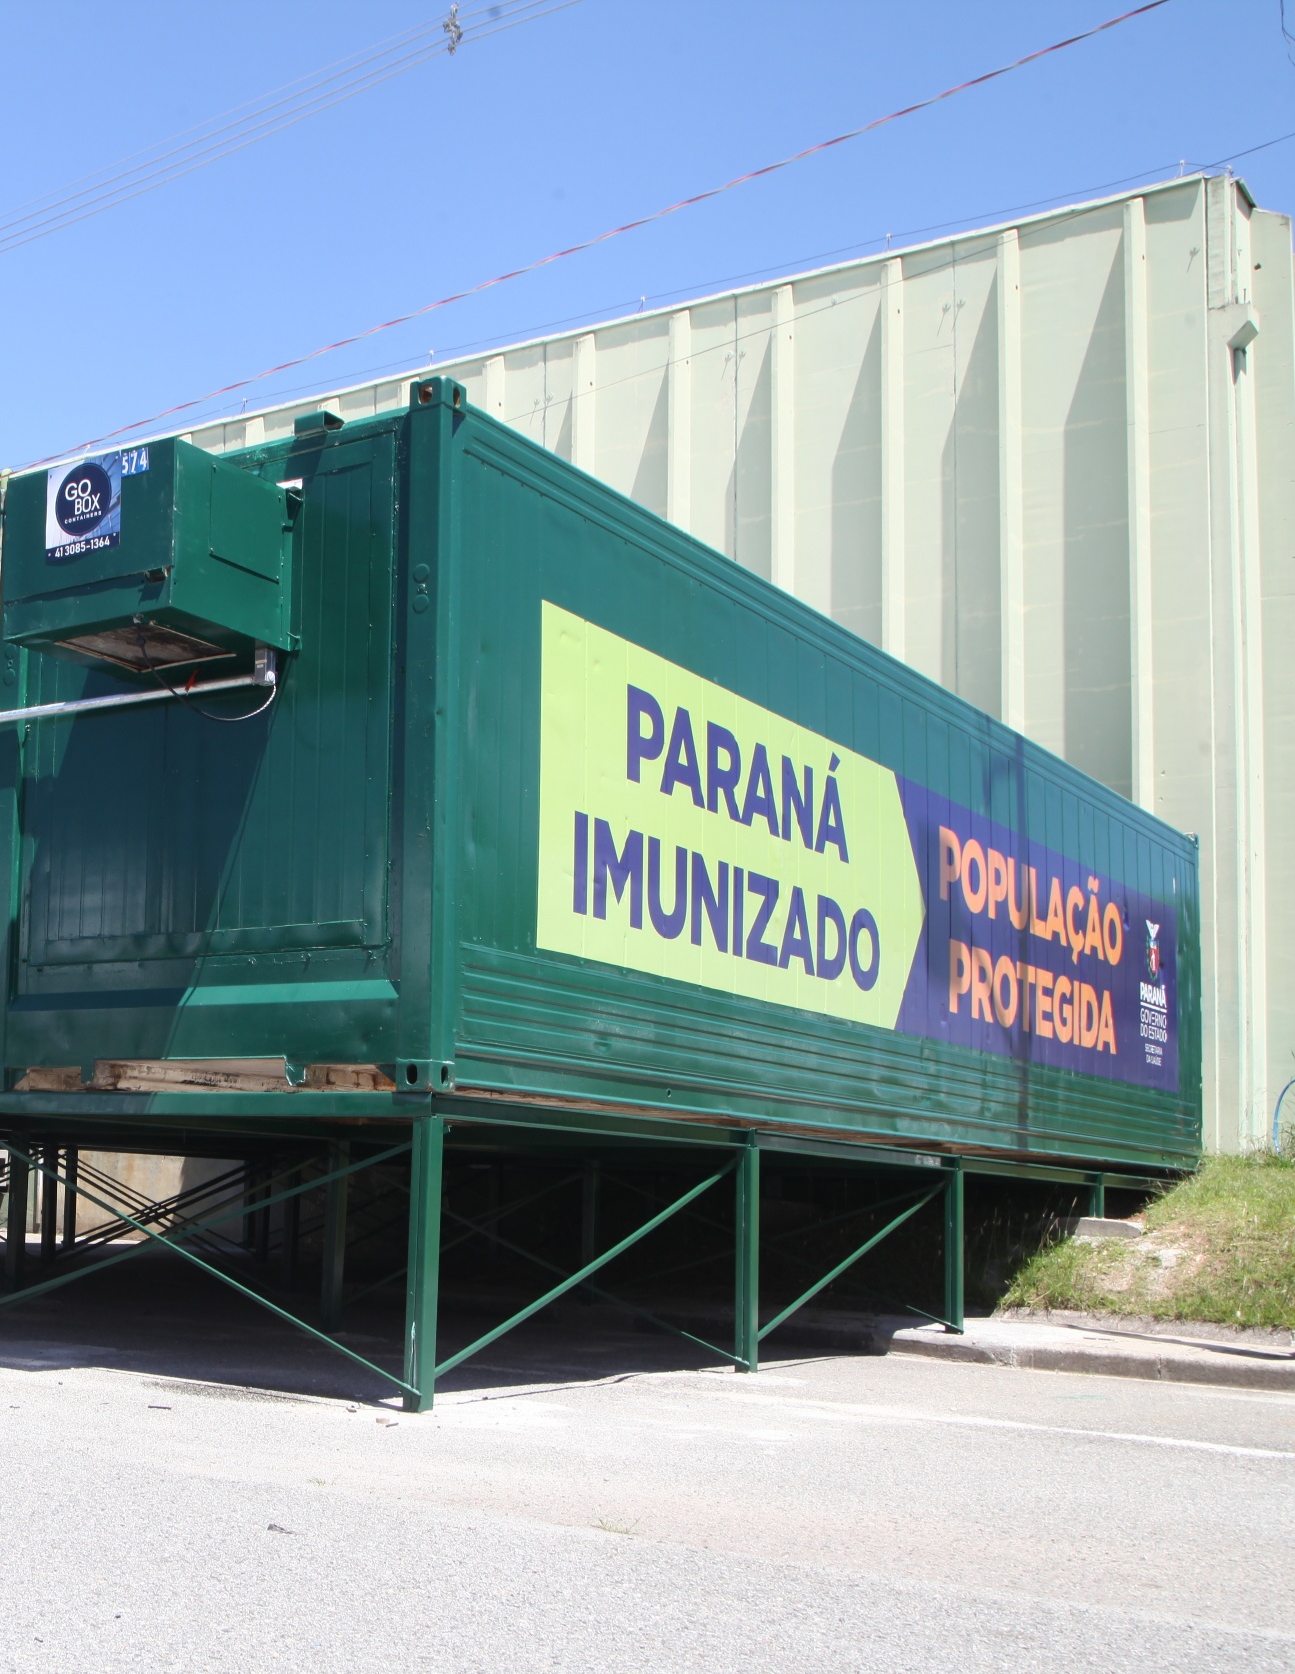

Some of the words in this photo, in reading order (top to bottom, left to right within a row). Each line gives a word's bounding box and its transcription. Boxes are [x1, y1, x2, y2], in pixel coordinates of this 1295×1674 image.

[121, 447, 148, 474] 574
[65, 479, 91, 501] GO
[74, 493, 100, 515] BOX
[64, 511, 102, 524] CONTAINERS
[626, 683, 849, 864] PARANÁ
[572, 810, 881, 992] IMUNIZADO
[939, 825, 1124, 966] POPULAÇÃO
[949, 938, 1117, 1055] PROTEGIDA
[1140, 982, 1167, 1008] PARANÁ
[1140, 1008, 1167, 1029] GOVERNO
[1140, 1024, 1148, 1038] DO
[1148, 1027, 1168, 1043] ESTADO
